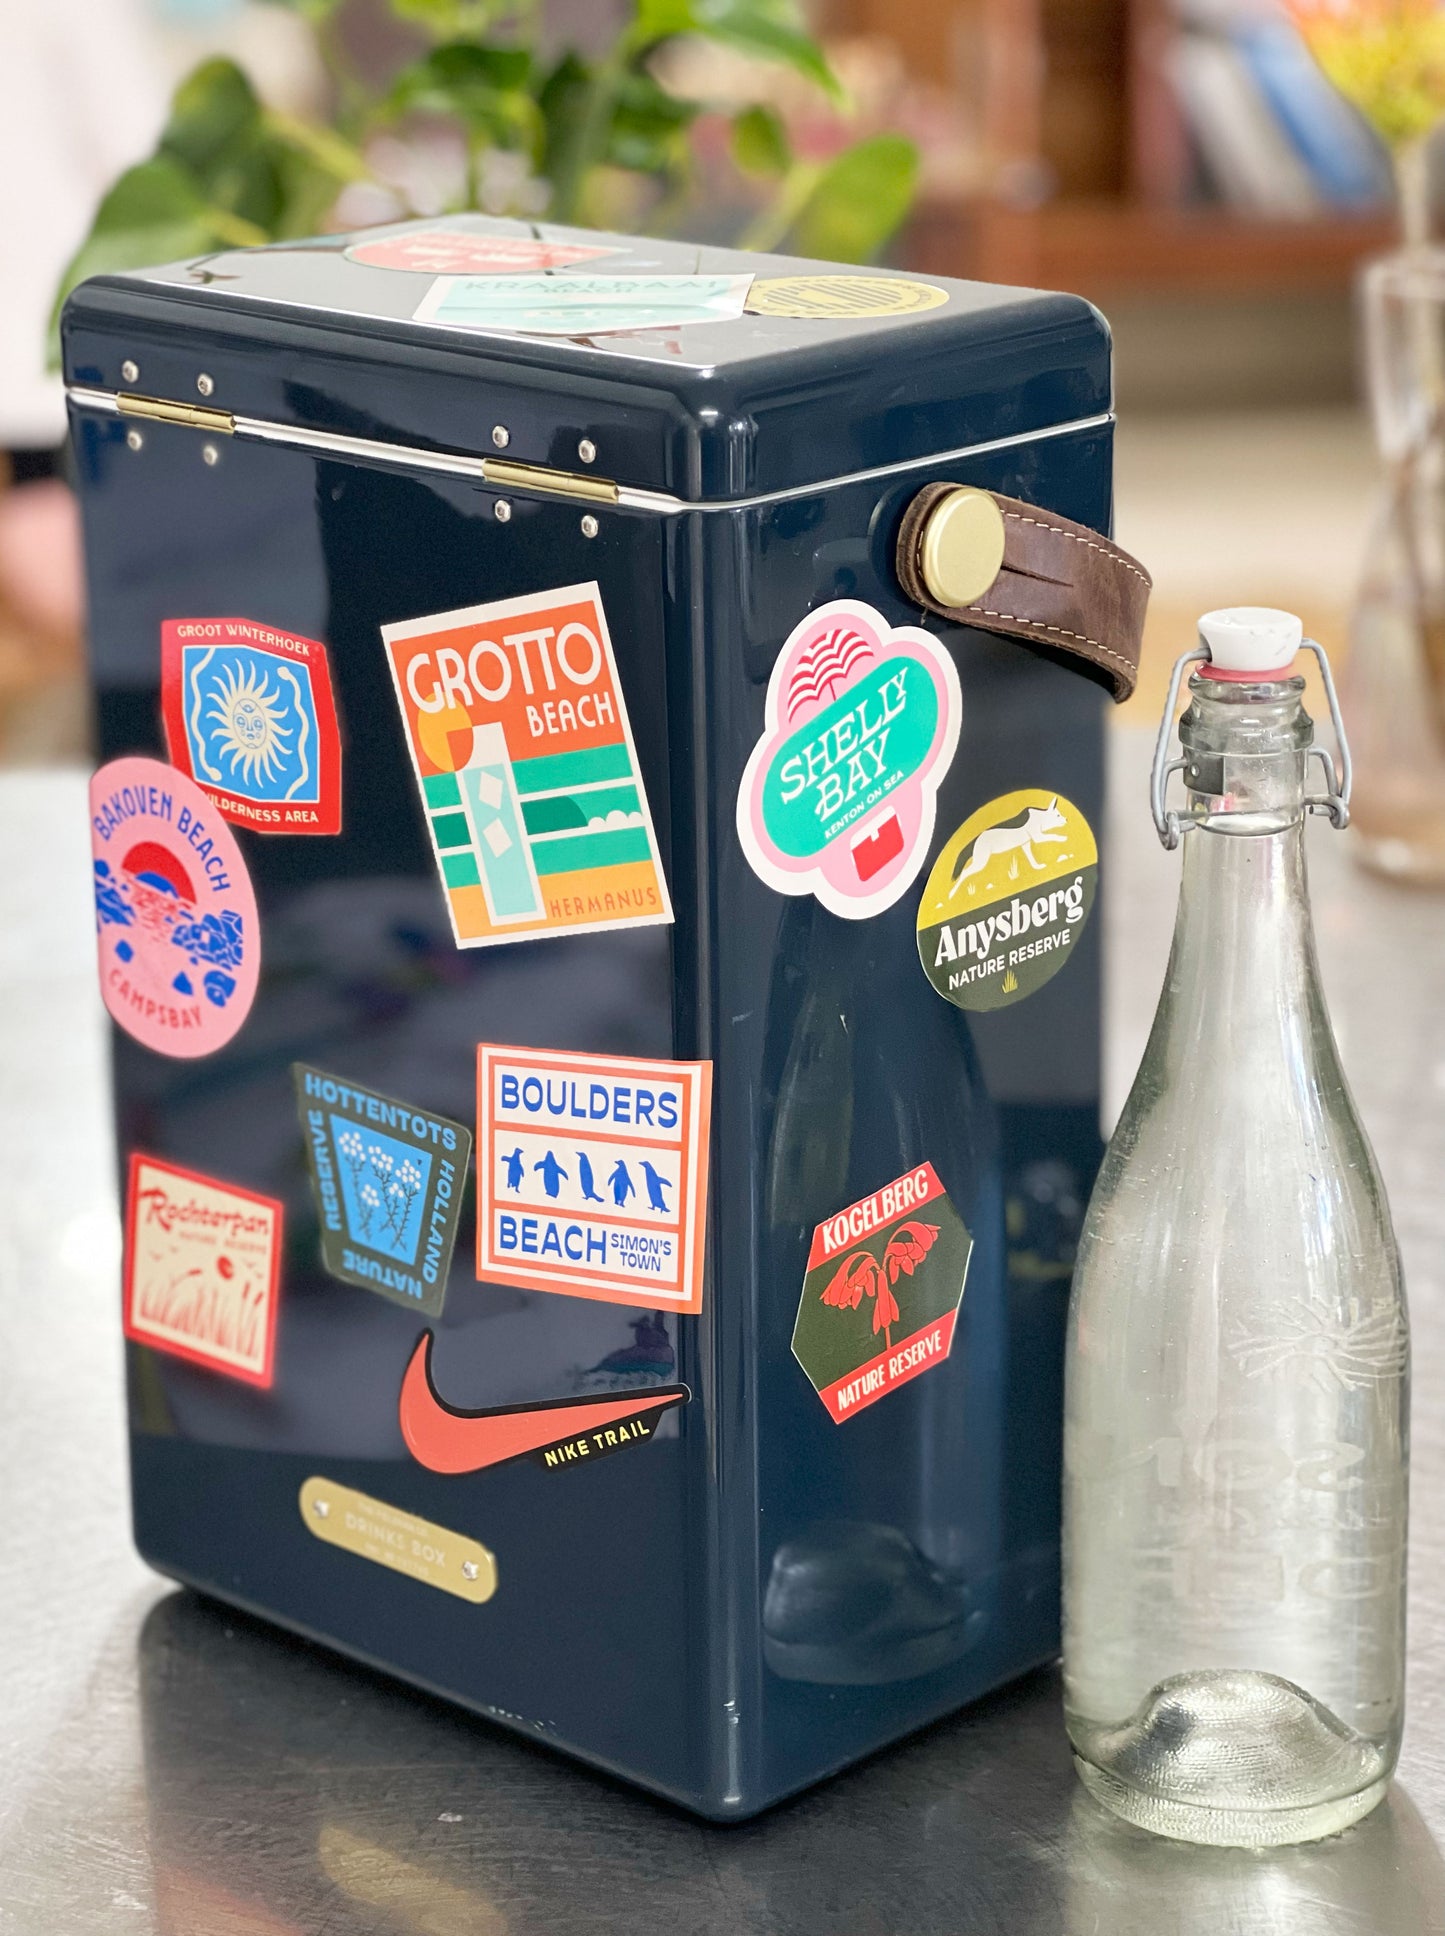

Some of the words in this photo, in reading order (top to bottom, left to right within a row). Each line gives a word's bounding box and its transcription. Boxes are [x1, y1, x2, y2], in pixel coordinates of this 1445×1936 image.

[177, 624, 221, 638] GROOT
[226, 624, 310, 656] WINTERHOEK
[406, 622, 602, 714] GROTTO
[526, 691, 615, 737] BEACH
[780, 667, 907, 806] SHELLY
[814, 727, 891, 822] BAY
[824, 801, 865, 839] KENTON
[866, 787, 883, 804] ON
[884, 770, 904, 790] SEA
[93, 784, 173, 841] BAKOVEN
[177, 805, 231, 893] BEACH
[207, 793, 280, 823] ILDERNESS
[285, 810, 319, 824] AREA
[550, 887, 657, 918] HERMANUS
[934, 876, 1083, 967] Anysberg
[948, 953, 1006, 991] NATURE
[1009, 929, 1071, 966] RESERVE
[305, 1072, 457, 1150] HOTTENTOTS
[501, 1074, 678, 1128] BOULDERS
[308, 1109, 342, 1231] RESERVE
[422, 1158, 456, 1284] HOLLAND
[500, 1215, 607, 1265] BEACH
[822, 1169, 928, 1255] KOGELBERG
[342, 1248, 423, 1300] NATURE
[611, 1233, 672, 1256] SIMON'S
[620, 1251, 662, 1272] TOWN
[837, 1364, 885, 1411] NATURE
[889, 1330, 942, 1379] RESERVE
[544, 1438, 590, 1467] NIKE
[593, 1419, 650, 1452] TRAIL
[345, 1512, 406, 1552] DRINKS
[411, 1538, 446, 1568] BOX
